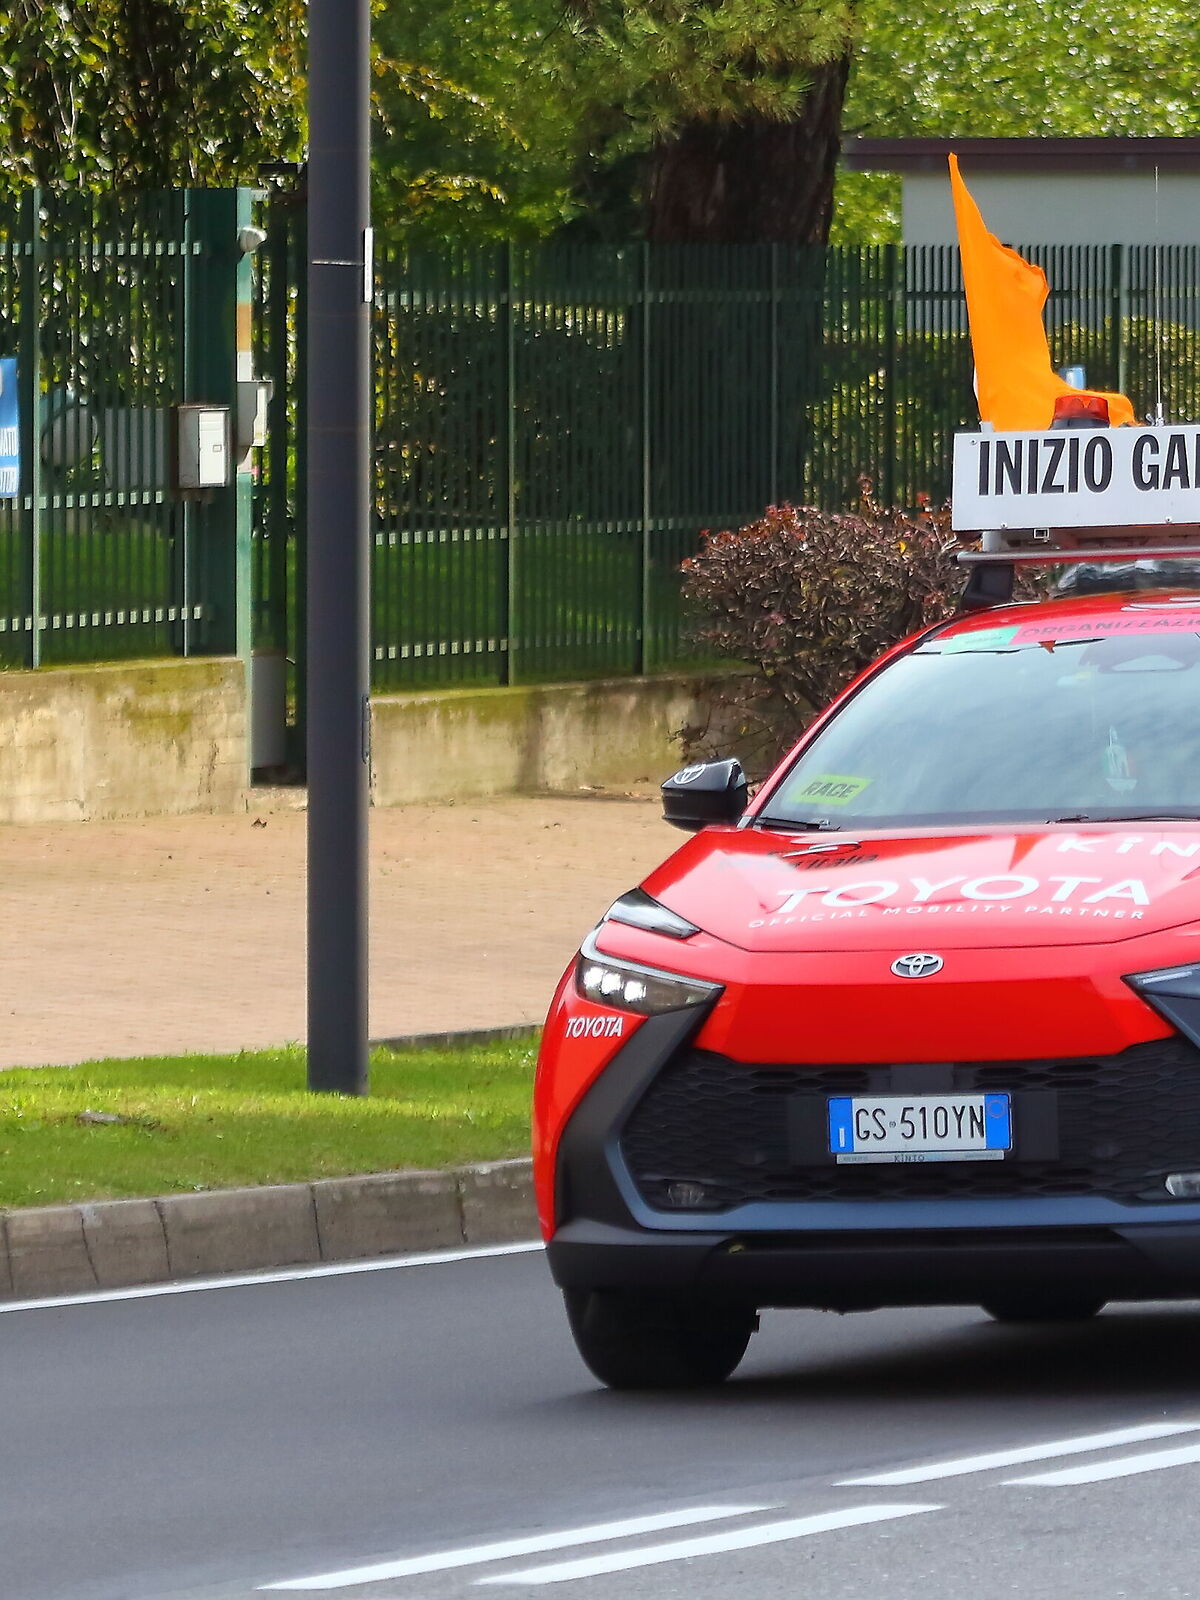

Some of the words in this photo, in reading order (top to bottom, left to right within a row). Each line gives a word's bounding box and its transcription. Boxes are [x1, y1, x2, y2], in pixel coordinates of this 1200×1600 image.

[978, 436, 1112, 497] INIZIO
[801, 781, 860, 798] RACE
[777, 875, 1151, 914] TOYOTA
[748, 910, 868, 928] OFFICIAL
[882, 904, 1013, 915] MOBILITY
[1024, 906, 1145, 920] PARTNER
[565, 1016, 624, 1038] TOYOTA
[855, 1107, 887, 1140] GS
[900, 1105, 985, 1140] 510YN
